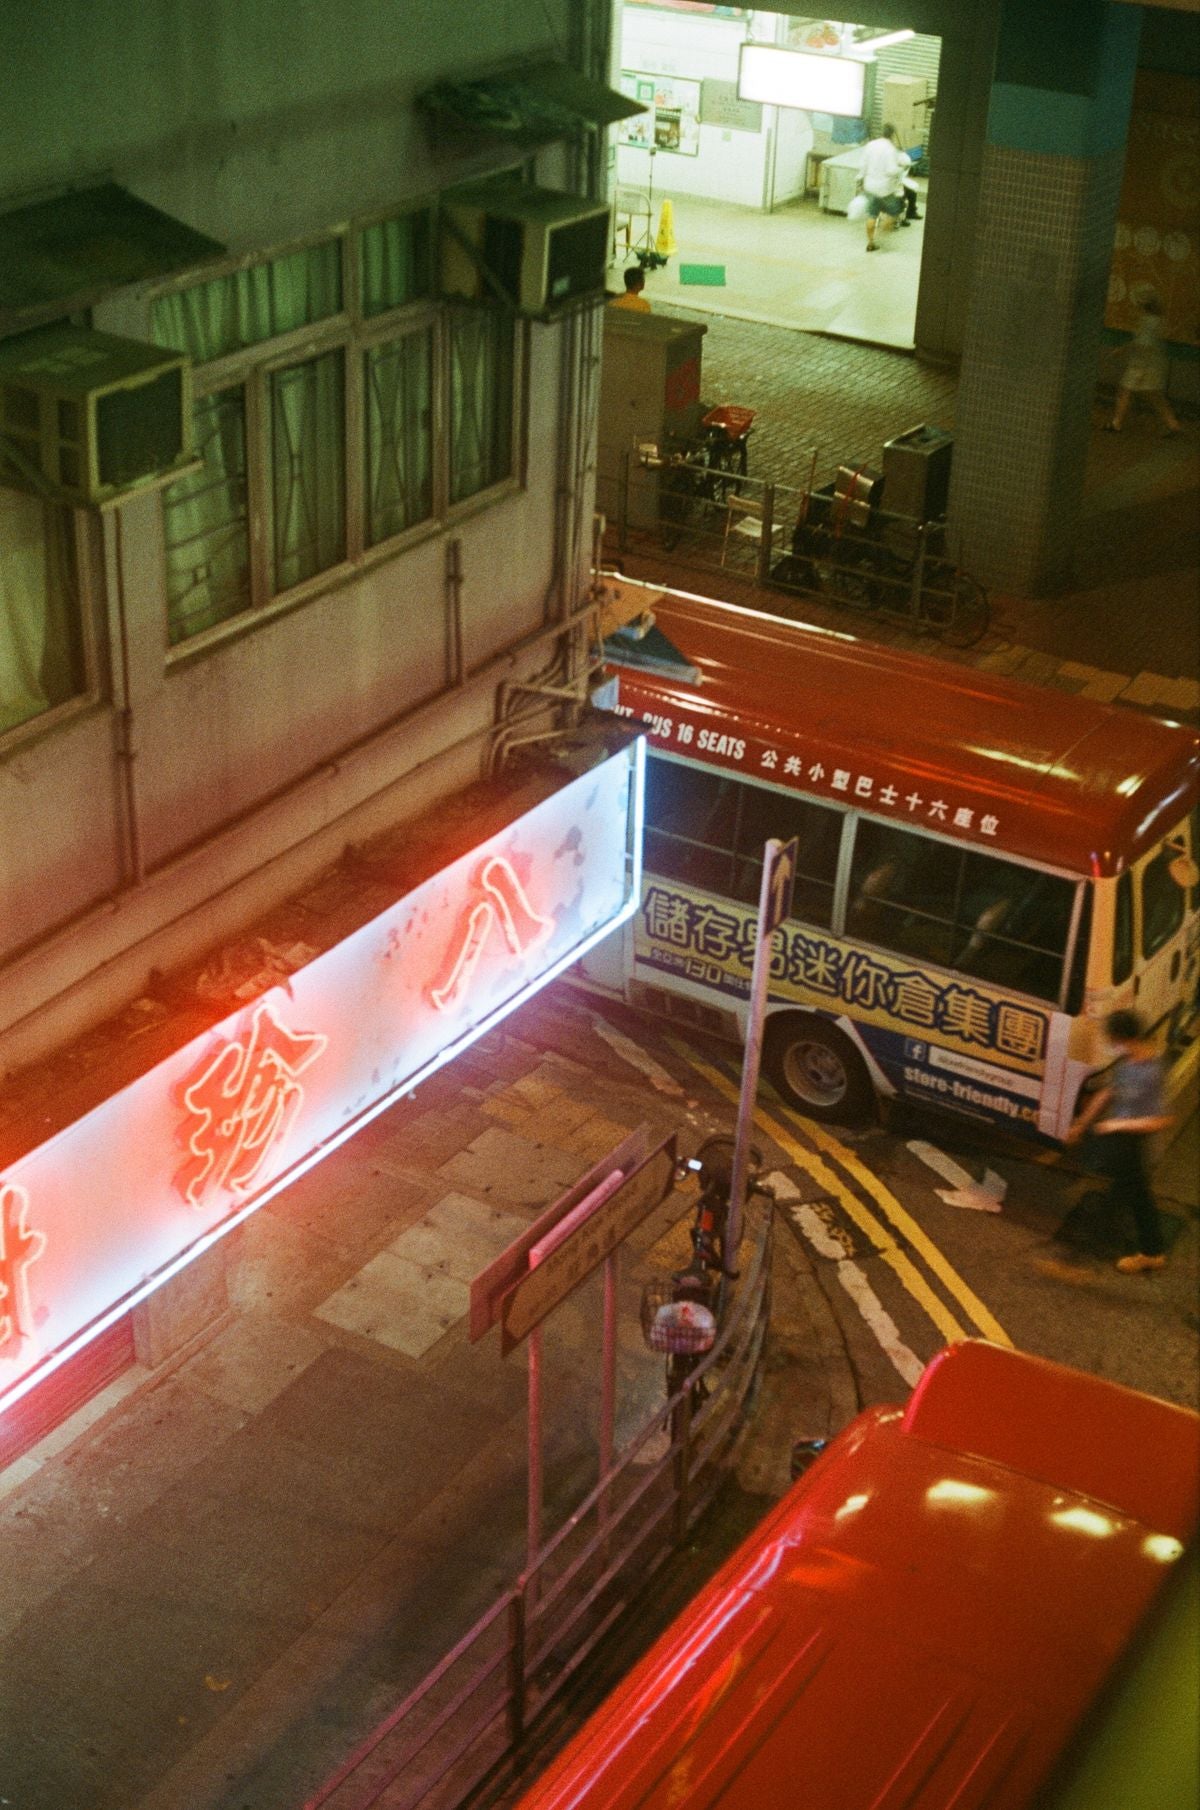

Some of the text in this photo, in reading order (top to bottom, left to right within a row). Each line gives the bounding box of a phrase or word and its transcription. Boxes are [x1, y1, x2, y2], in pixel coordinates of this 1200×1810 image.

[677, 723, 694, 744] 16
[697, 729, 746, 760] SEATS
[642, 890, 1049, 1062] 儲存易迷你倉集團
